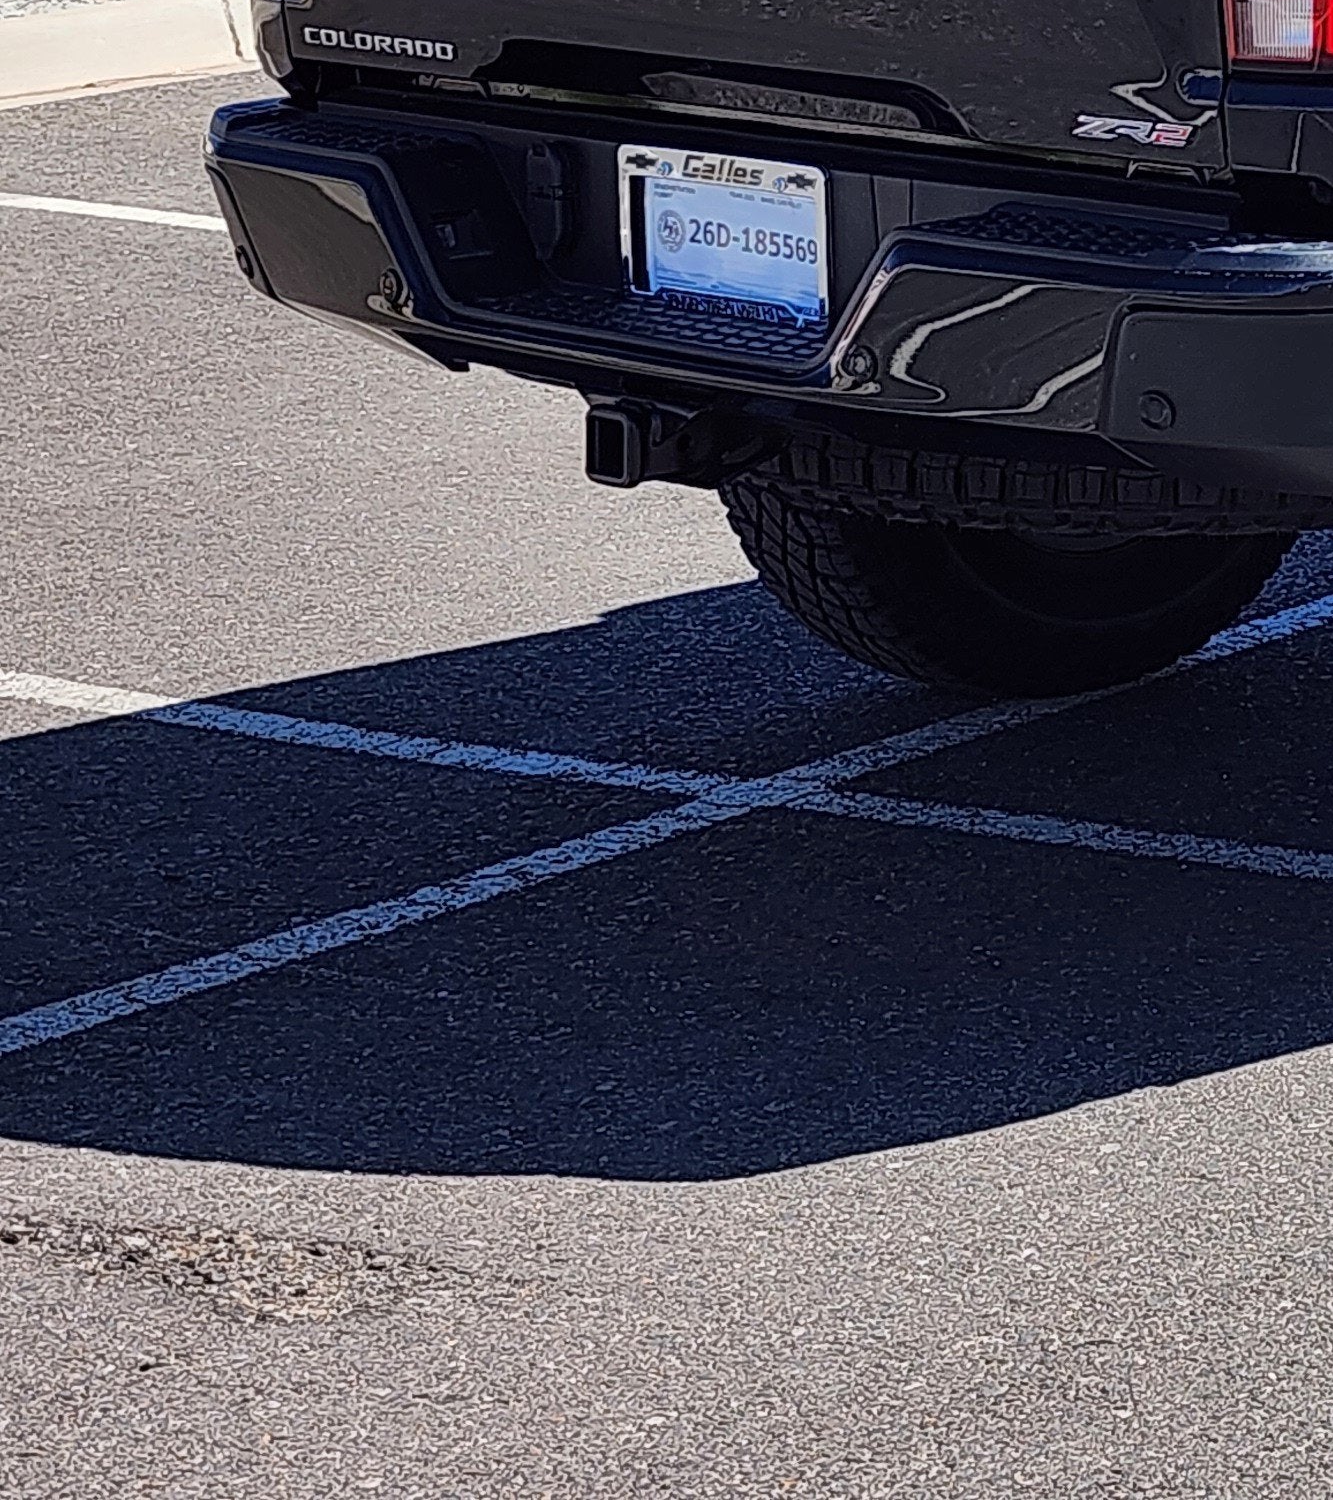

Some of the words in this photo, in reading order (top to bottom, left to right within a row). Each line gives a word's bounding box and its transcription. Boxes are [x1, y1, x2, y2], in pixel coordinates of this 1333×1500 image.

[303, 26, 455, 61] COLORADO
[1071, 114, 1194, 148] ZR2
[682, 153, 765, 187] Galles
[688, 217, 819, 265] 26D-185569
